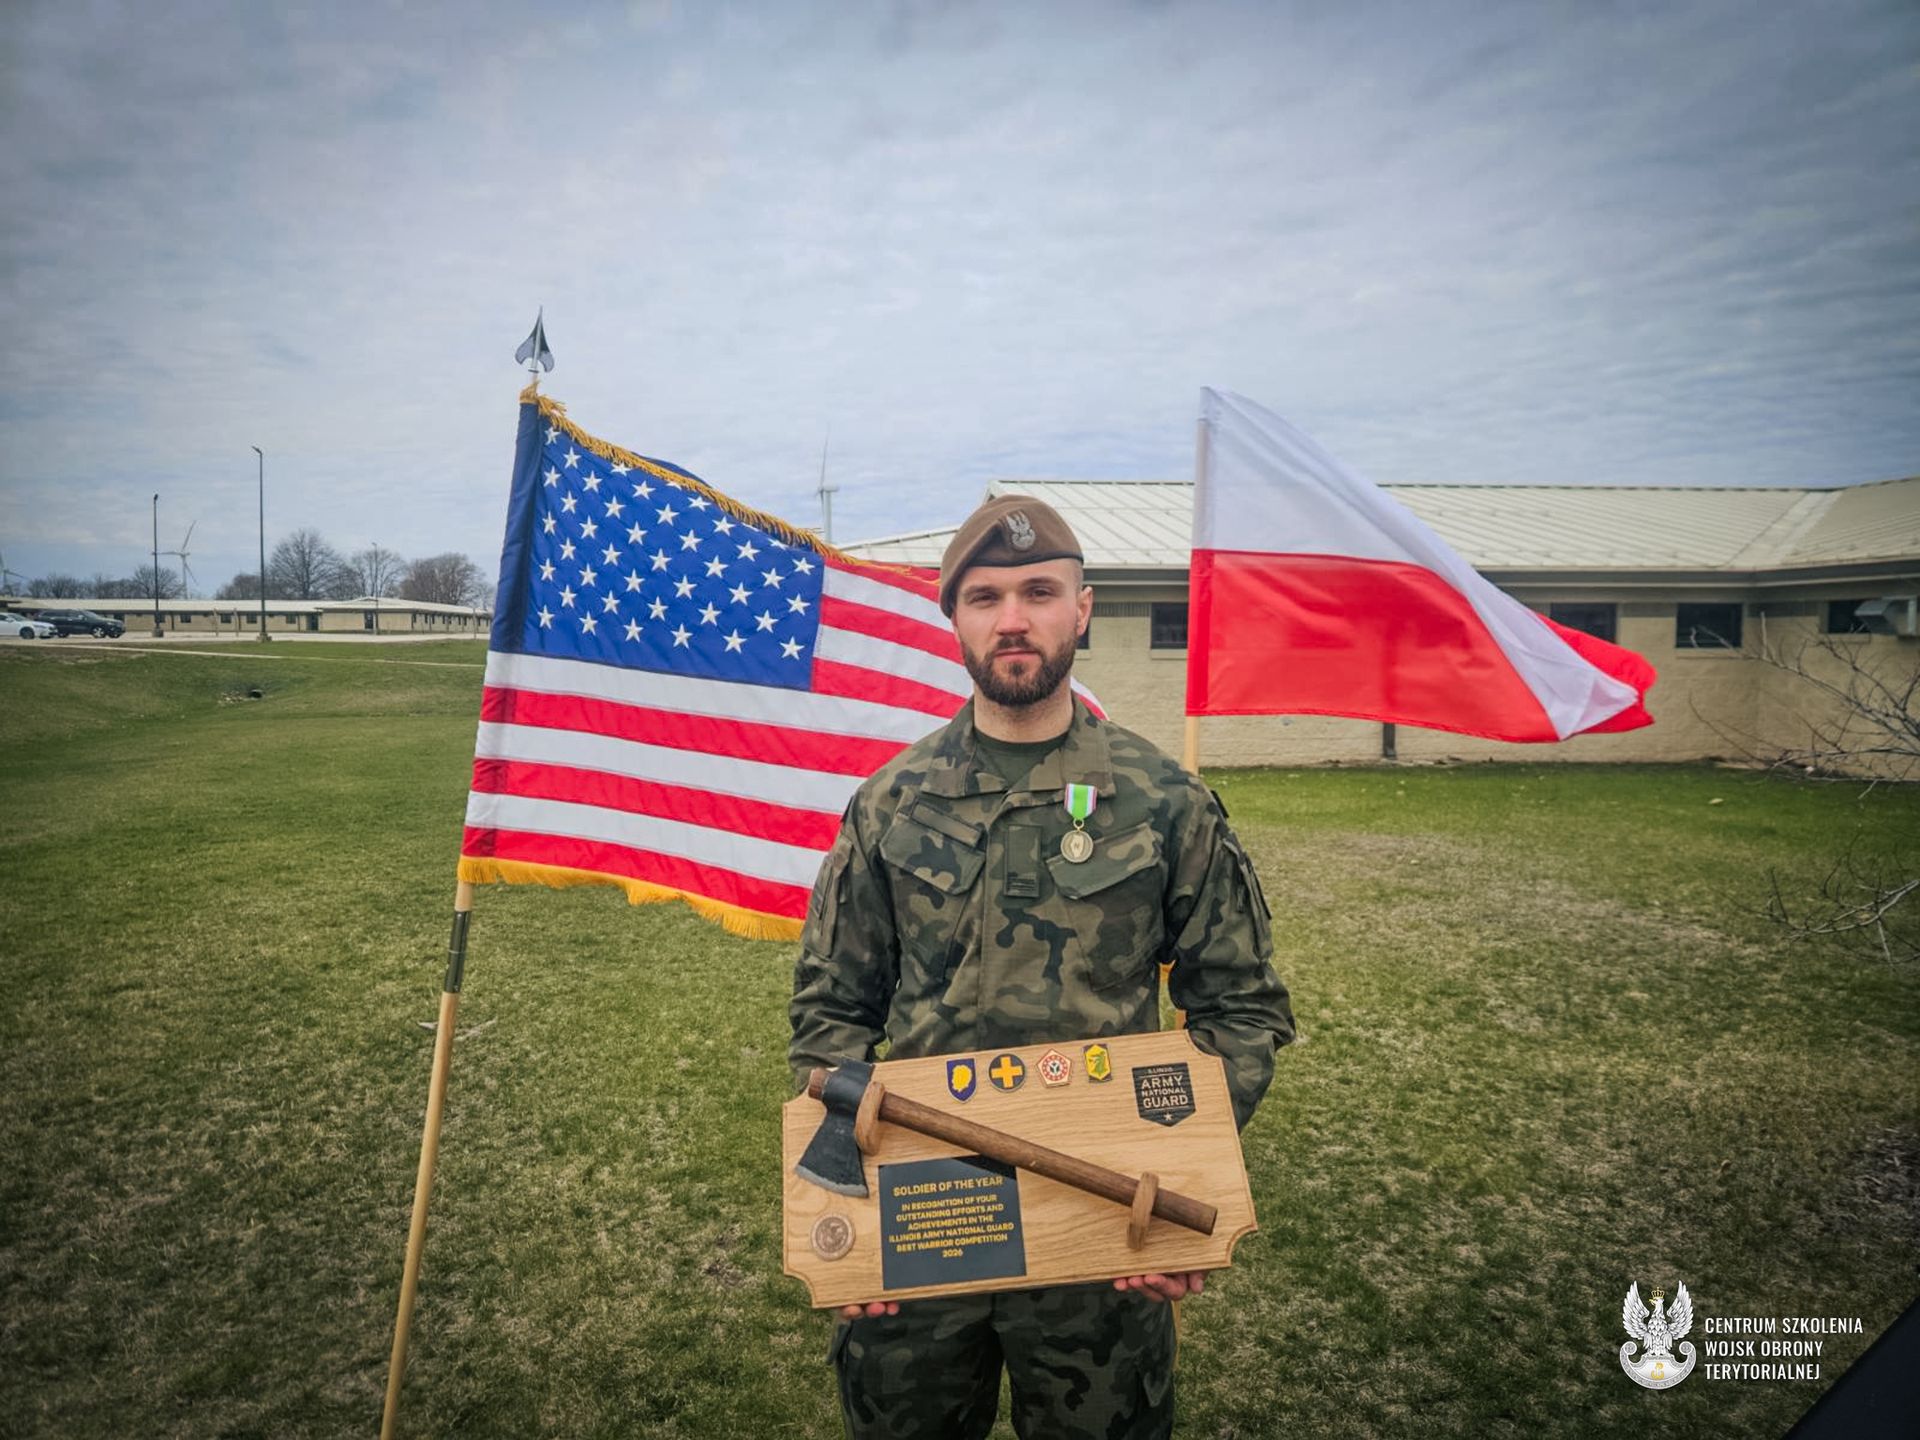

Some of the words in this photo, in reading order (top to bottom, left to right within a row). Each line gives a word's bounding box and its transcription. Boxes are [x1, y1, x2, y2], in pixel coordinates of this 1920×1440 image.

[1142, 1074, 1183, 1089] ARMY
[1141, 1087, 1186, 1097] NATIONAL
[1143, 1094, 1188, 1108] GUARD
[893, 1183, 936, 1197] SOLDIER
[939, 1181, 952, 1191] OF
[954, 1179, 974, 1190] THE
[976, 1176, 1004, 1187] YEAR
[902, 1203, 910, 1211] IN
[912, 1198, 963, 1210] RECOGNITION
[976, 1194, 997, 1203] YOUR
[896, 1209, 951, 1222] OUTSTANDING
[952, 1206, 985, 1215] EFFORTS
[987, 1204, 1004, 1212] AND
[908, 1217, 967, 1231] ACHIEVEMENTS
[978, 1215, 994, 1223] THE
[889, 1234, 921, 1243] ILLINOIS
[923, 1231, 946, 1239] ARMY
[946, 1226, 986, 1236] NATIONAL
[987, 1222, 1014, 1231] GUARD
[896, 1244, 916, 1252] BEST
[918, 1240, 953, 1250] WARRIOR
[955, 1234, 1008, 1246] COMPETITION
